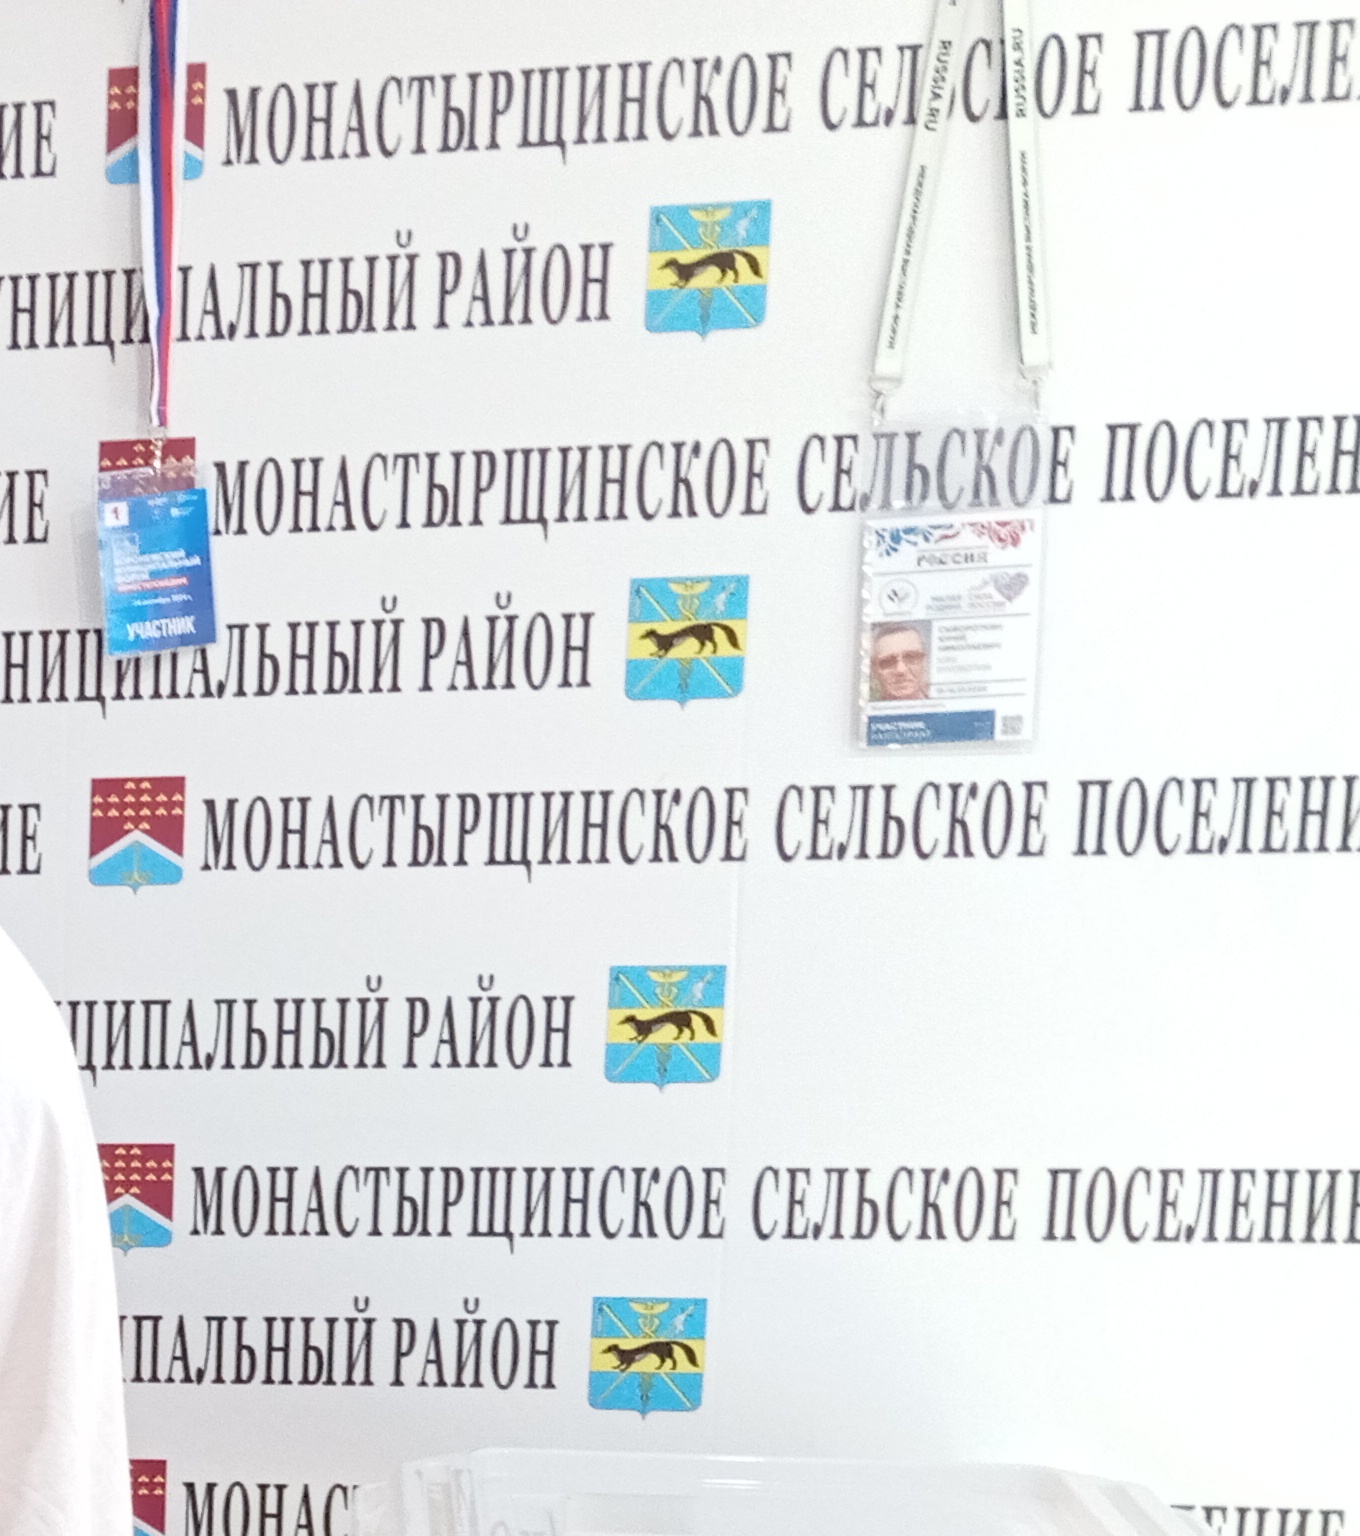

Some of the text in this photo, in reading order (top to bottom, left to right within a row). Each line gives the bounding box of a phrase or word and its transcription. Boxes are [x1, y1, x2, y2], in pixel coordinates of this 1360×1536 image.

[221, 18, 1360, 167] МОНАСТЫРЩИНСКОЕ СЕЛСОЕ ПОСЕЛЕ
[433, 222, 614, 330] РАЙОН
[212, 414, 1360, 541] МОНАСТЫРЩИНСКОЕ СЕЛЬСКОЕ ПОСЕЛЕН
[126, 615, 197, 642] УЧАСТНИК
[418, 591, 595, 692] РАЙОН
[200, 786, 749, 883] МОНАСТЫРЩИНСКОЕ
[775, 780, 1048, 863] СЕЛЬСКОЕ
[54, 974, 575, 1087] ЦИПАЛЬНЫЙ РАЙОН
[189, 1164, 726, 1254] МОНАСТЫРЩИНСКОЕ
[752, 1165, 1019, 1242] СЕЛЬСКОЕ
[389, 1297, 560, 1390] РАЙОН
